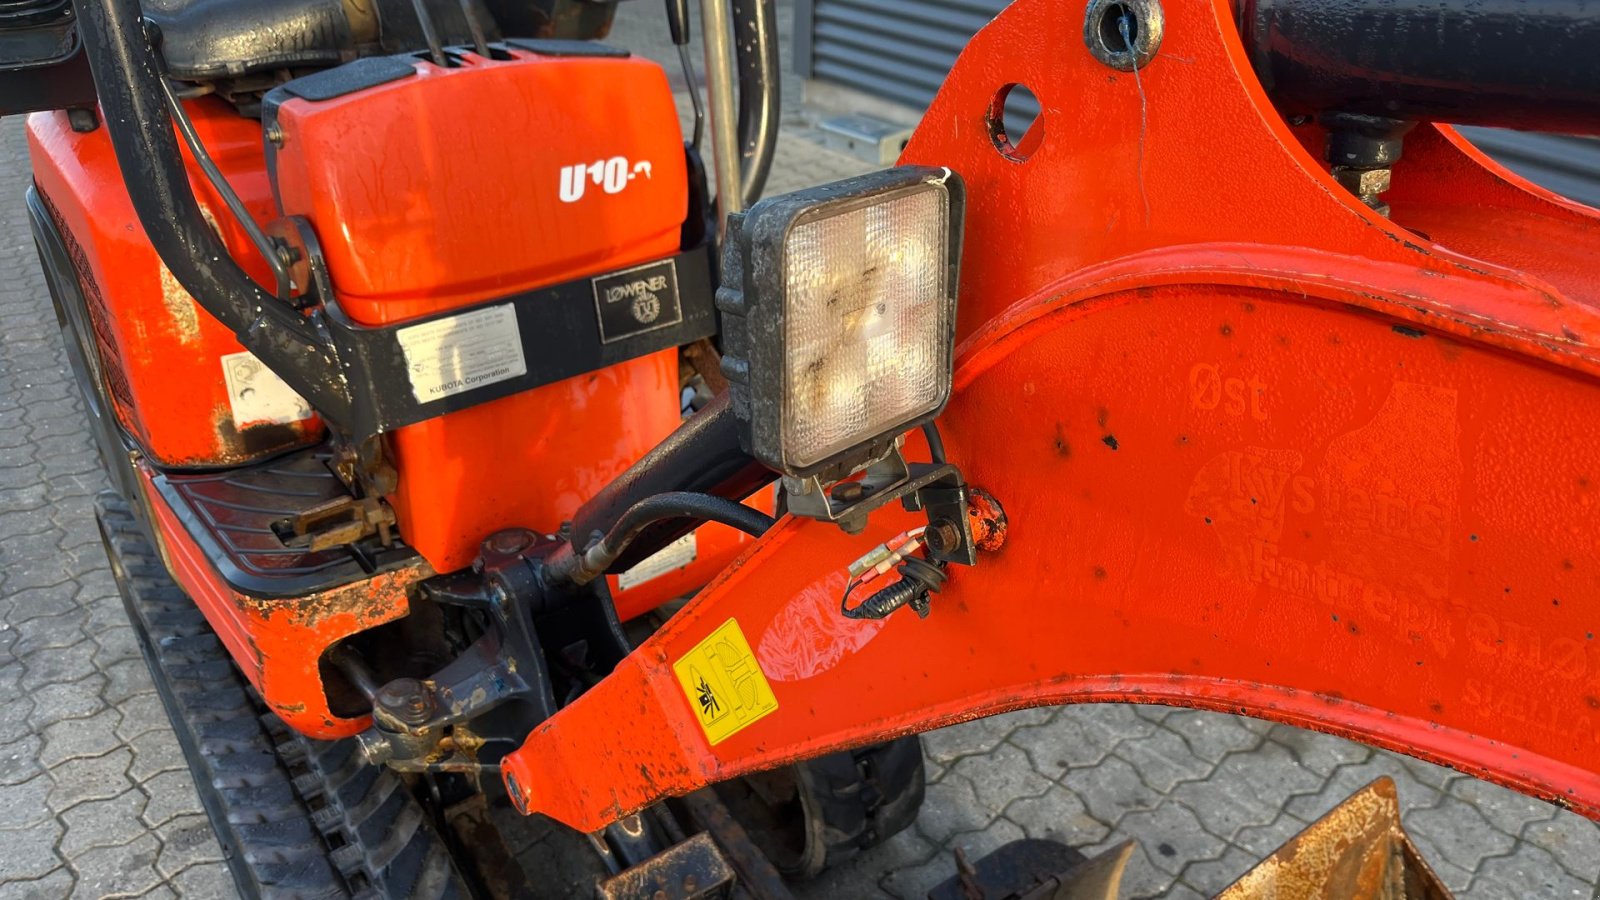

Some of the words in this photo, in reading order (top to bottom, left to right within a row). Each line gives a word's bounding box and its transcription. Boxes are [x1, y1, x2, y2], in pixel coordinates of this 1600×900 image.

[605, 275, 668, 304] LØWENER
[429, 379, 464, 395] KUBOTA
[465, 366, 510, 385] Corporation
[1188, 361, 1268, 422] Øst
